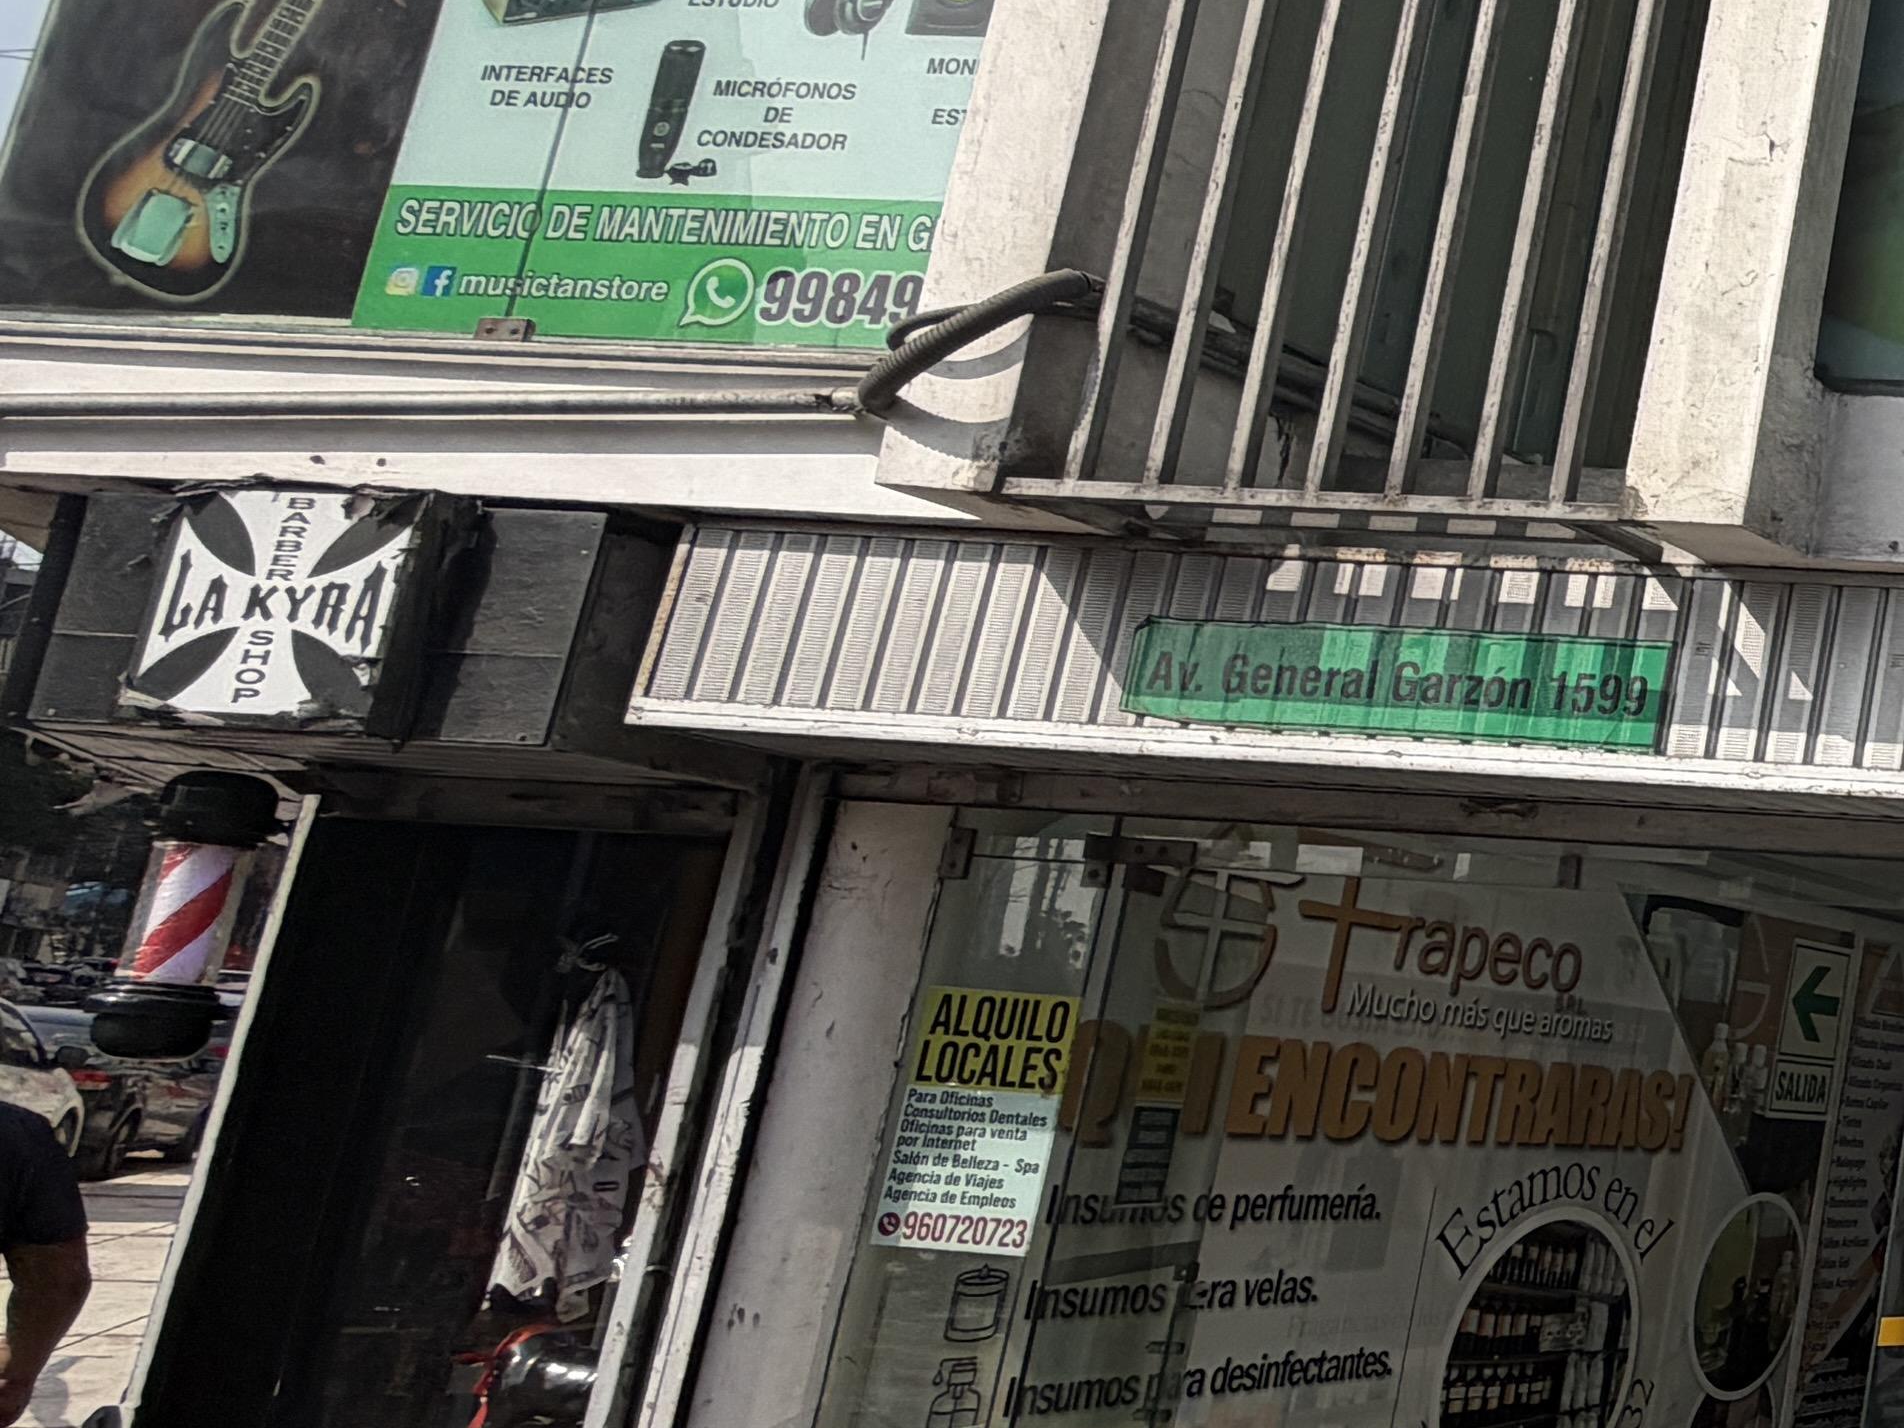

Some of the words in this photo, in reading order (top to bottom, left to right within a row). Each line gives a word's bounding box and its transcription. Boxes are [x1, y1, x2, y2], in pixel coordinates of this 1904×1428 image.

[480, 64, 614, 86] INTERFACES
[713, 77, 857, 100] MICRÓFONOS
[490, 89, 520, 108] DE
[524, 90, 592, 109] AUDIO
[763, 106, 793, 124] DE
[696, 129, 847, 151] CONDESADOR
[395, 199, 540, 237] SERVICIO
[545, 203, 591, 240] DE
[596, 206, 849, 250] MANTENIMIENTO
[855, 213, 900, 250] EN
[459, 270, 670, 303] musictanstore
[266, 496, 317, 582] BARBER
[158, 549, 228, 643] LA
[241, 560, 389, 655] KYRA
[231, 631, 275, 704] SHOP
[1147, 650, 1203, 694] Av.
[1221, 654, 1381, 701] General
[1391, 660, 1532, 710] Garzón
[1547, 671, 1649, 719] 1599
[930, 994, 1071, 1045] ALQUILO
[915, 1040, 1062, 1091] LOCALES
[907, 1088, 936, 1105] Para
[939, 1090, 993, 1108] Oficinas
[1226, 1035, 1696, 1153] ENCONTRARAS!
[904, 1104, 986, 1124] Consultorios
[989, 1110, 1048, 1127] Dentales
[888, 1168, 941, 1186] Agencia
[944, 1171, 960, 1186] de
[964, 1172, 1005, 1190] Viajes
[884, 1186, 938, 1204] Agencia
[940, 1190, 956, 1205] de
[960, 1191, 1017, 1209] Empleos
[903, 1211, 1027, 1248] 960720723
